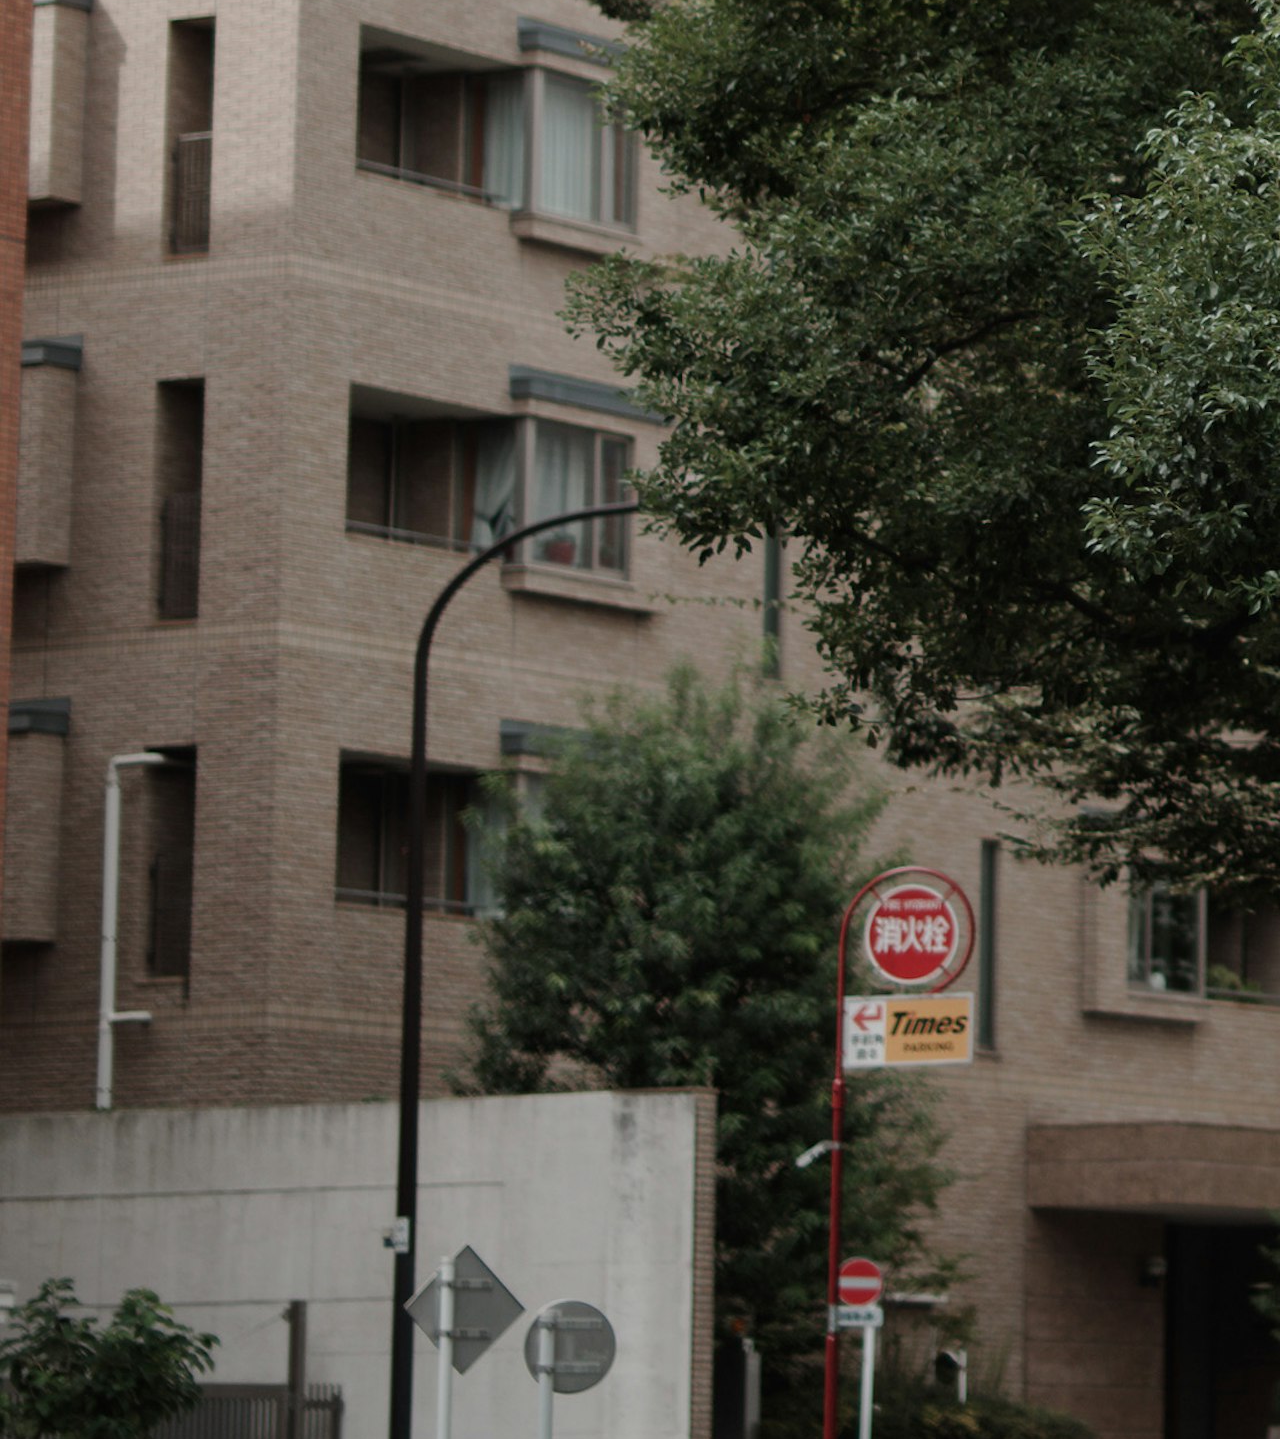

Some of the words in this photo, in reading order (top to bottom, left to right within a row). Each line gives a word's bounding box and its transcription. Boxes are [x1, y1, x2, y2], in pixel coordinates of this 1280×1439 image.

[874, 916, 949, 954] 消火栓
[891, 1011, 968, 1036] Times
[903, 1041, 954, 1053] PARKING
